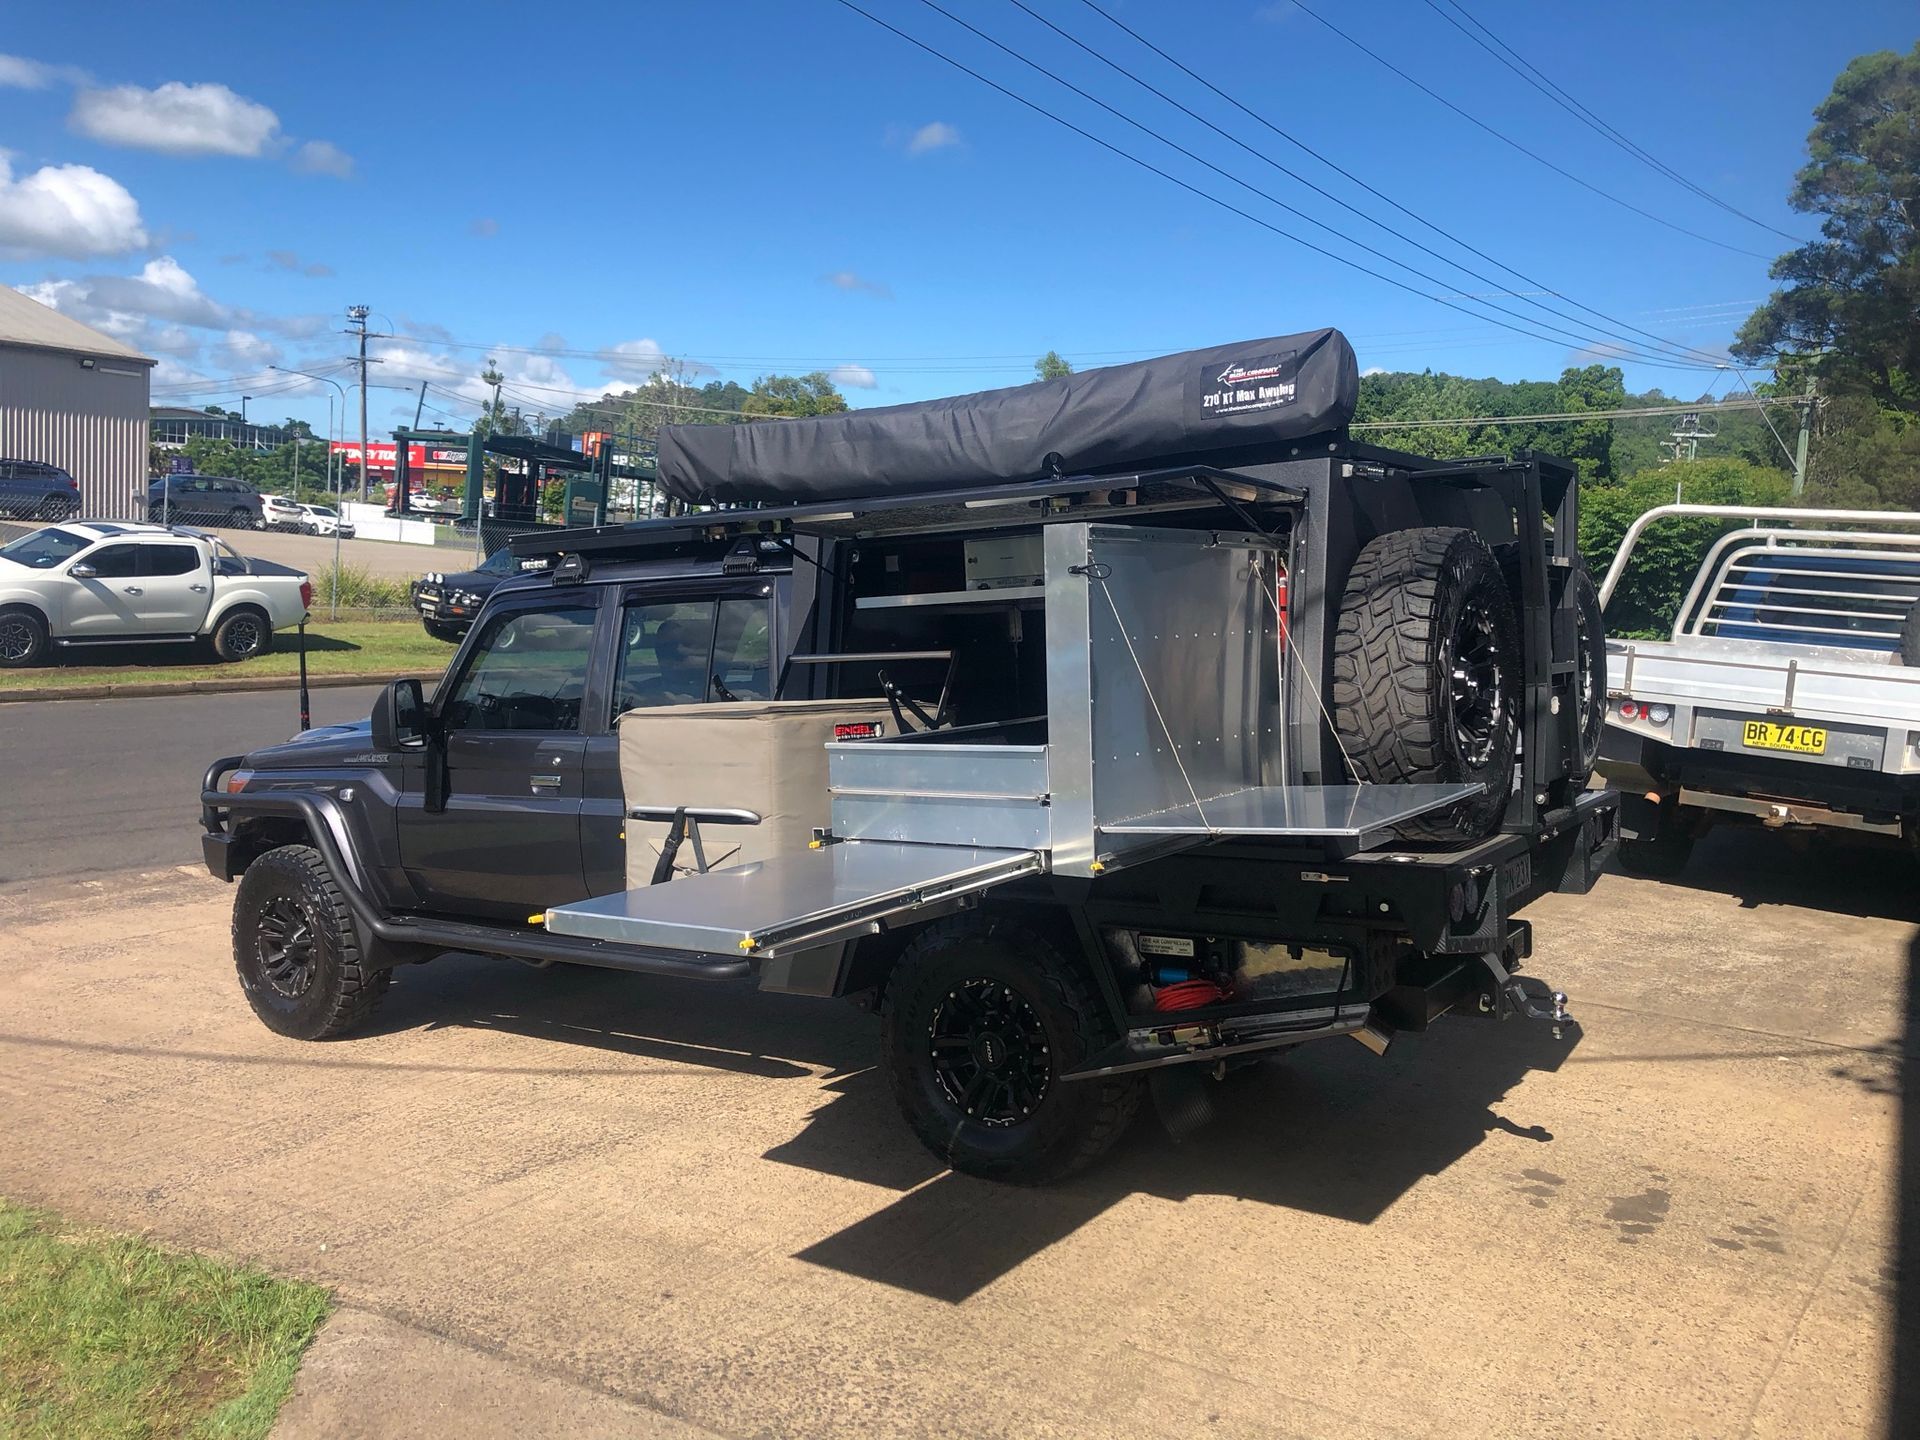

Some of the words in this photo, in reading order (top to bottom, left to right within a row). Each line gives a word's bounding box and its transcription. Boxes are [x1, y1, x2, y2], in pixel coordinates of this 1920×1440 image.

[1229, 371, 1247, 379] BUSH
[1247, 366, 1279, 377] COMPANY
[1222, 391, 1234, 405] XT
[1236, 389, 1256, 403] Max
[1258, 383, 1295, 399] Awning
[1215, 399, 1284, 414] www.thebushcompany.com
[445, 450, 468, 463] Repco
[835, 725, 874, 736] ENGEL
[1769, 742, 1791, 750] SOUTH
[1793, 745, 1815, 753] WALES
